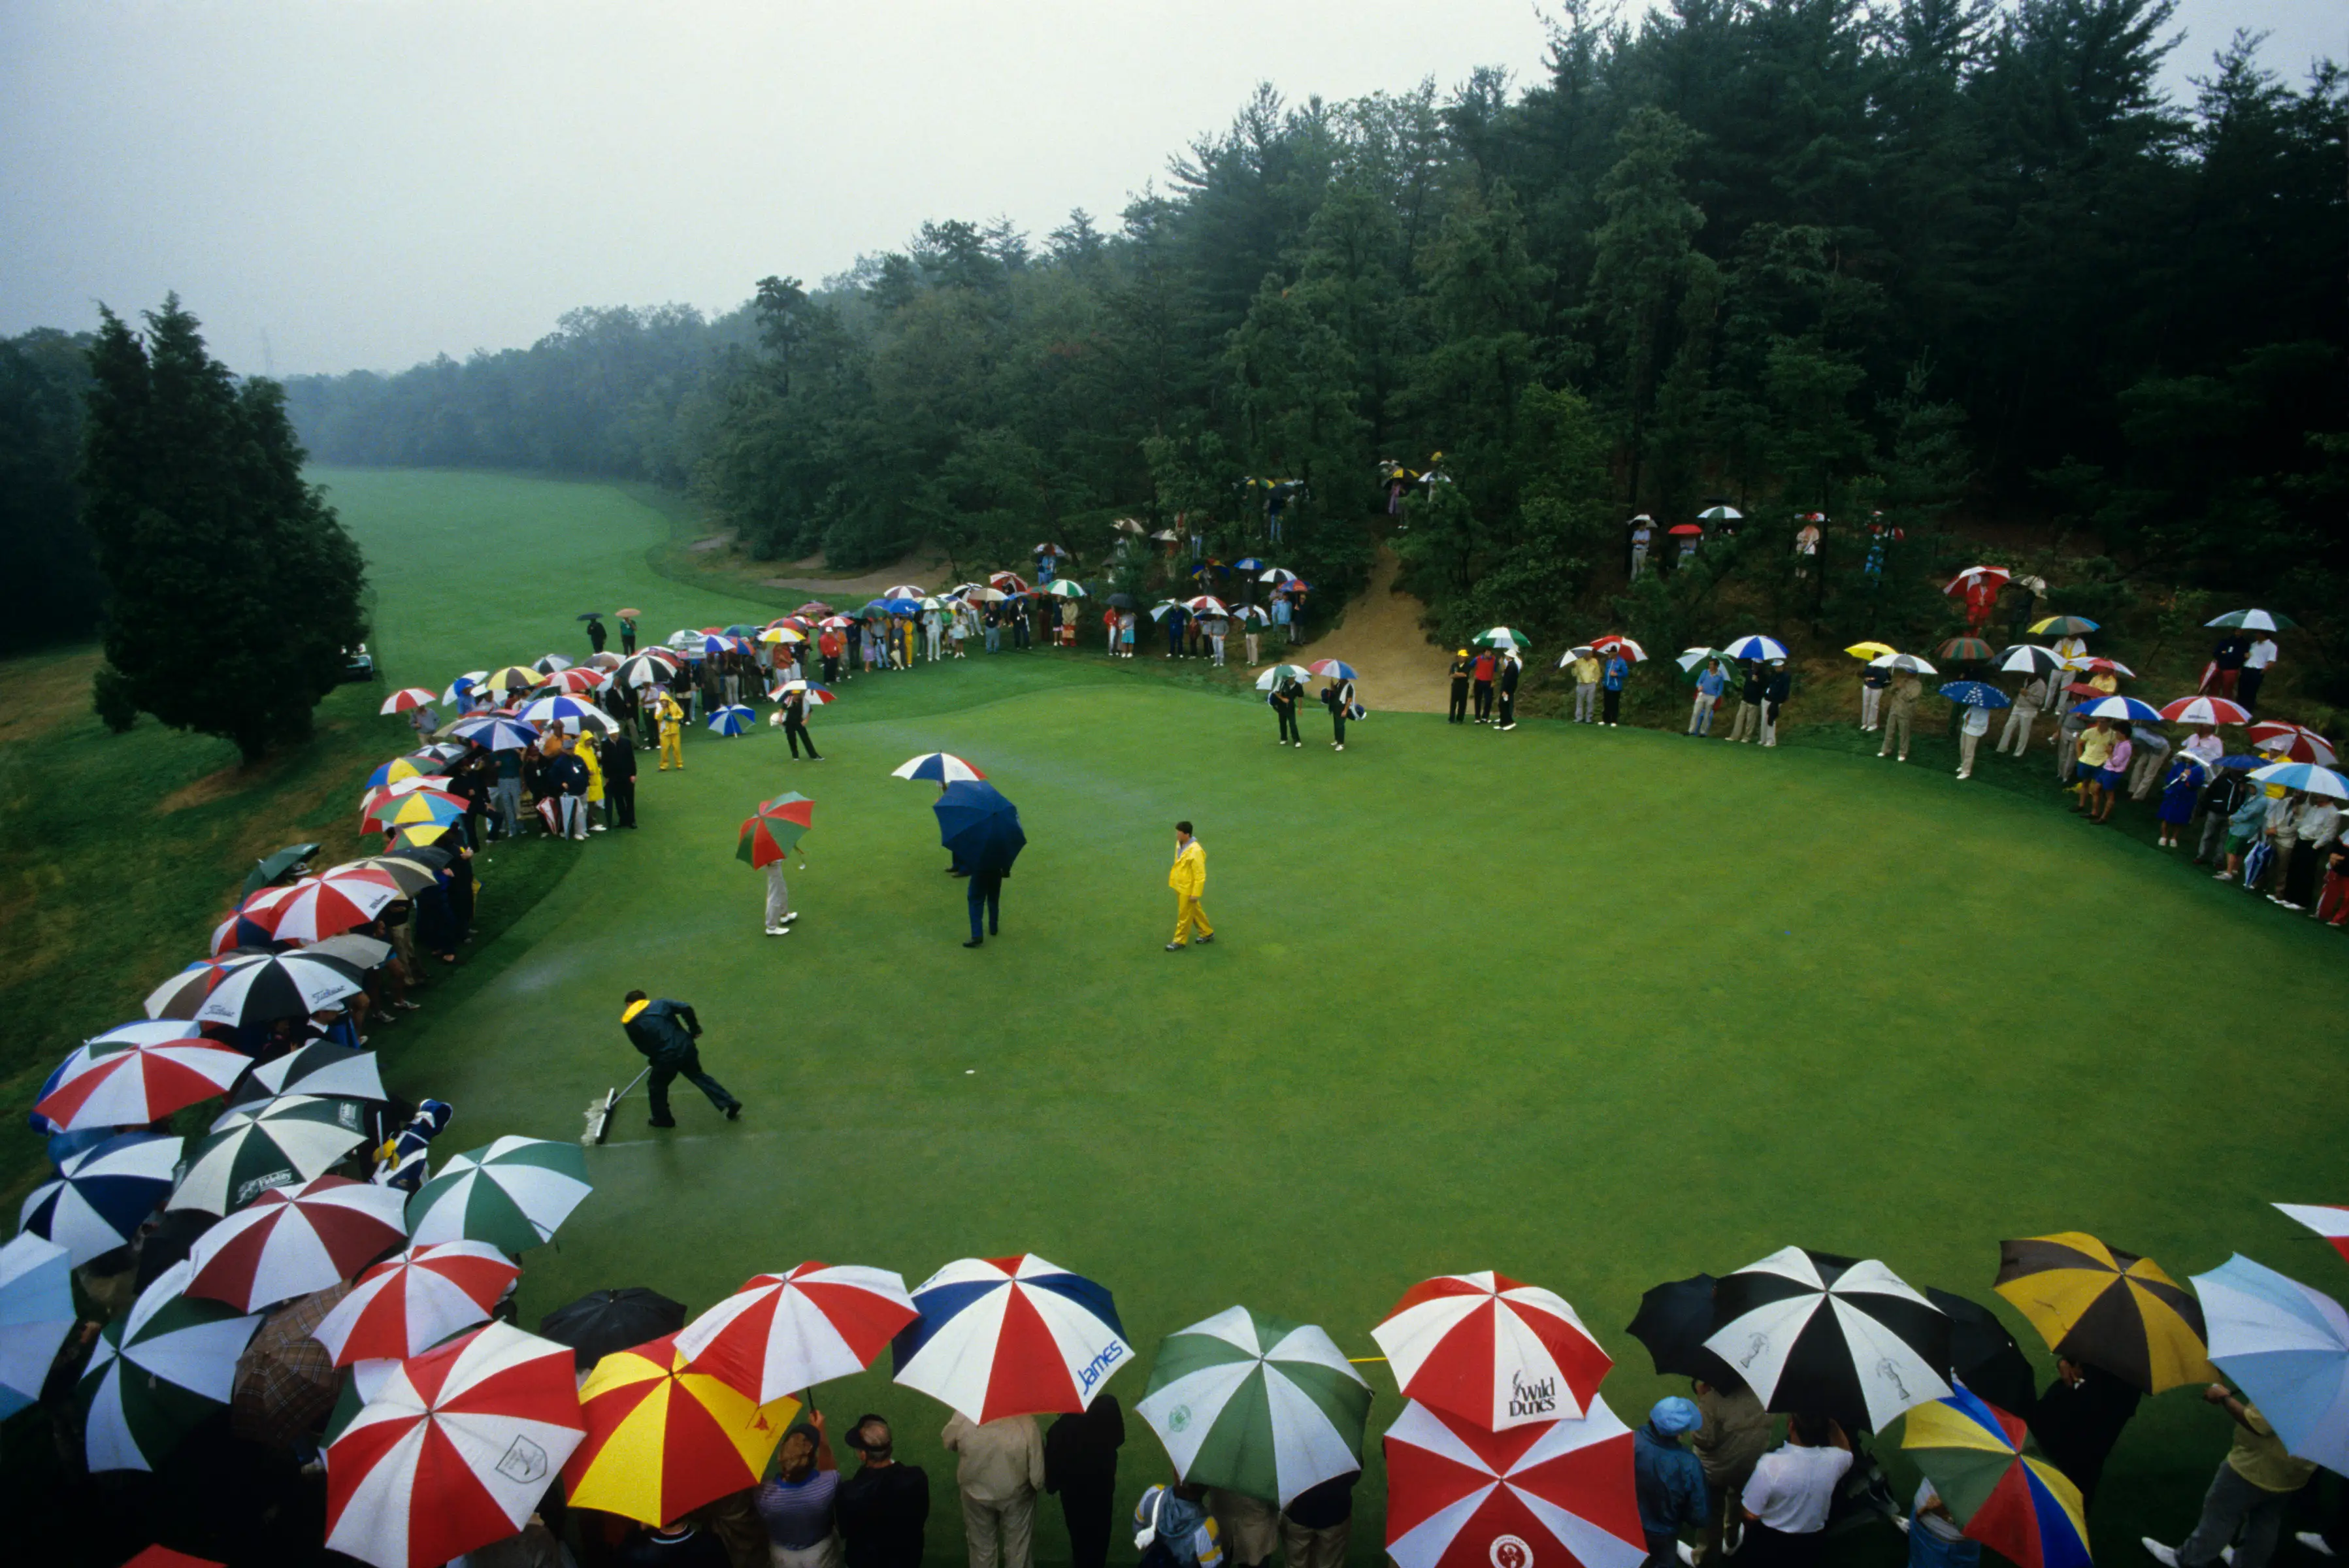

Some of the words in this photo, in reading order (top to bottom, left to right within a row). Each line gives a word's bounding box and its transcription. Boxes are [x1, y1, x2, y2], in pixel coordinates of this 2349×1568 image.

[1077, 1339, 1123, 1396] James
[1521, 1377, 1555, 1401] Wild
[1509, 1397, 1556, 1417] Dunes
